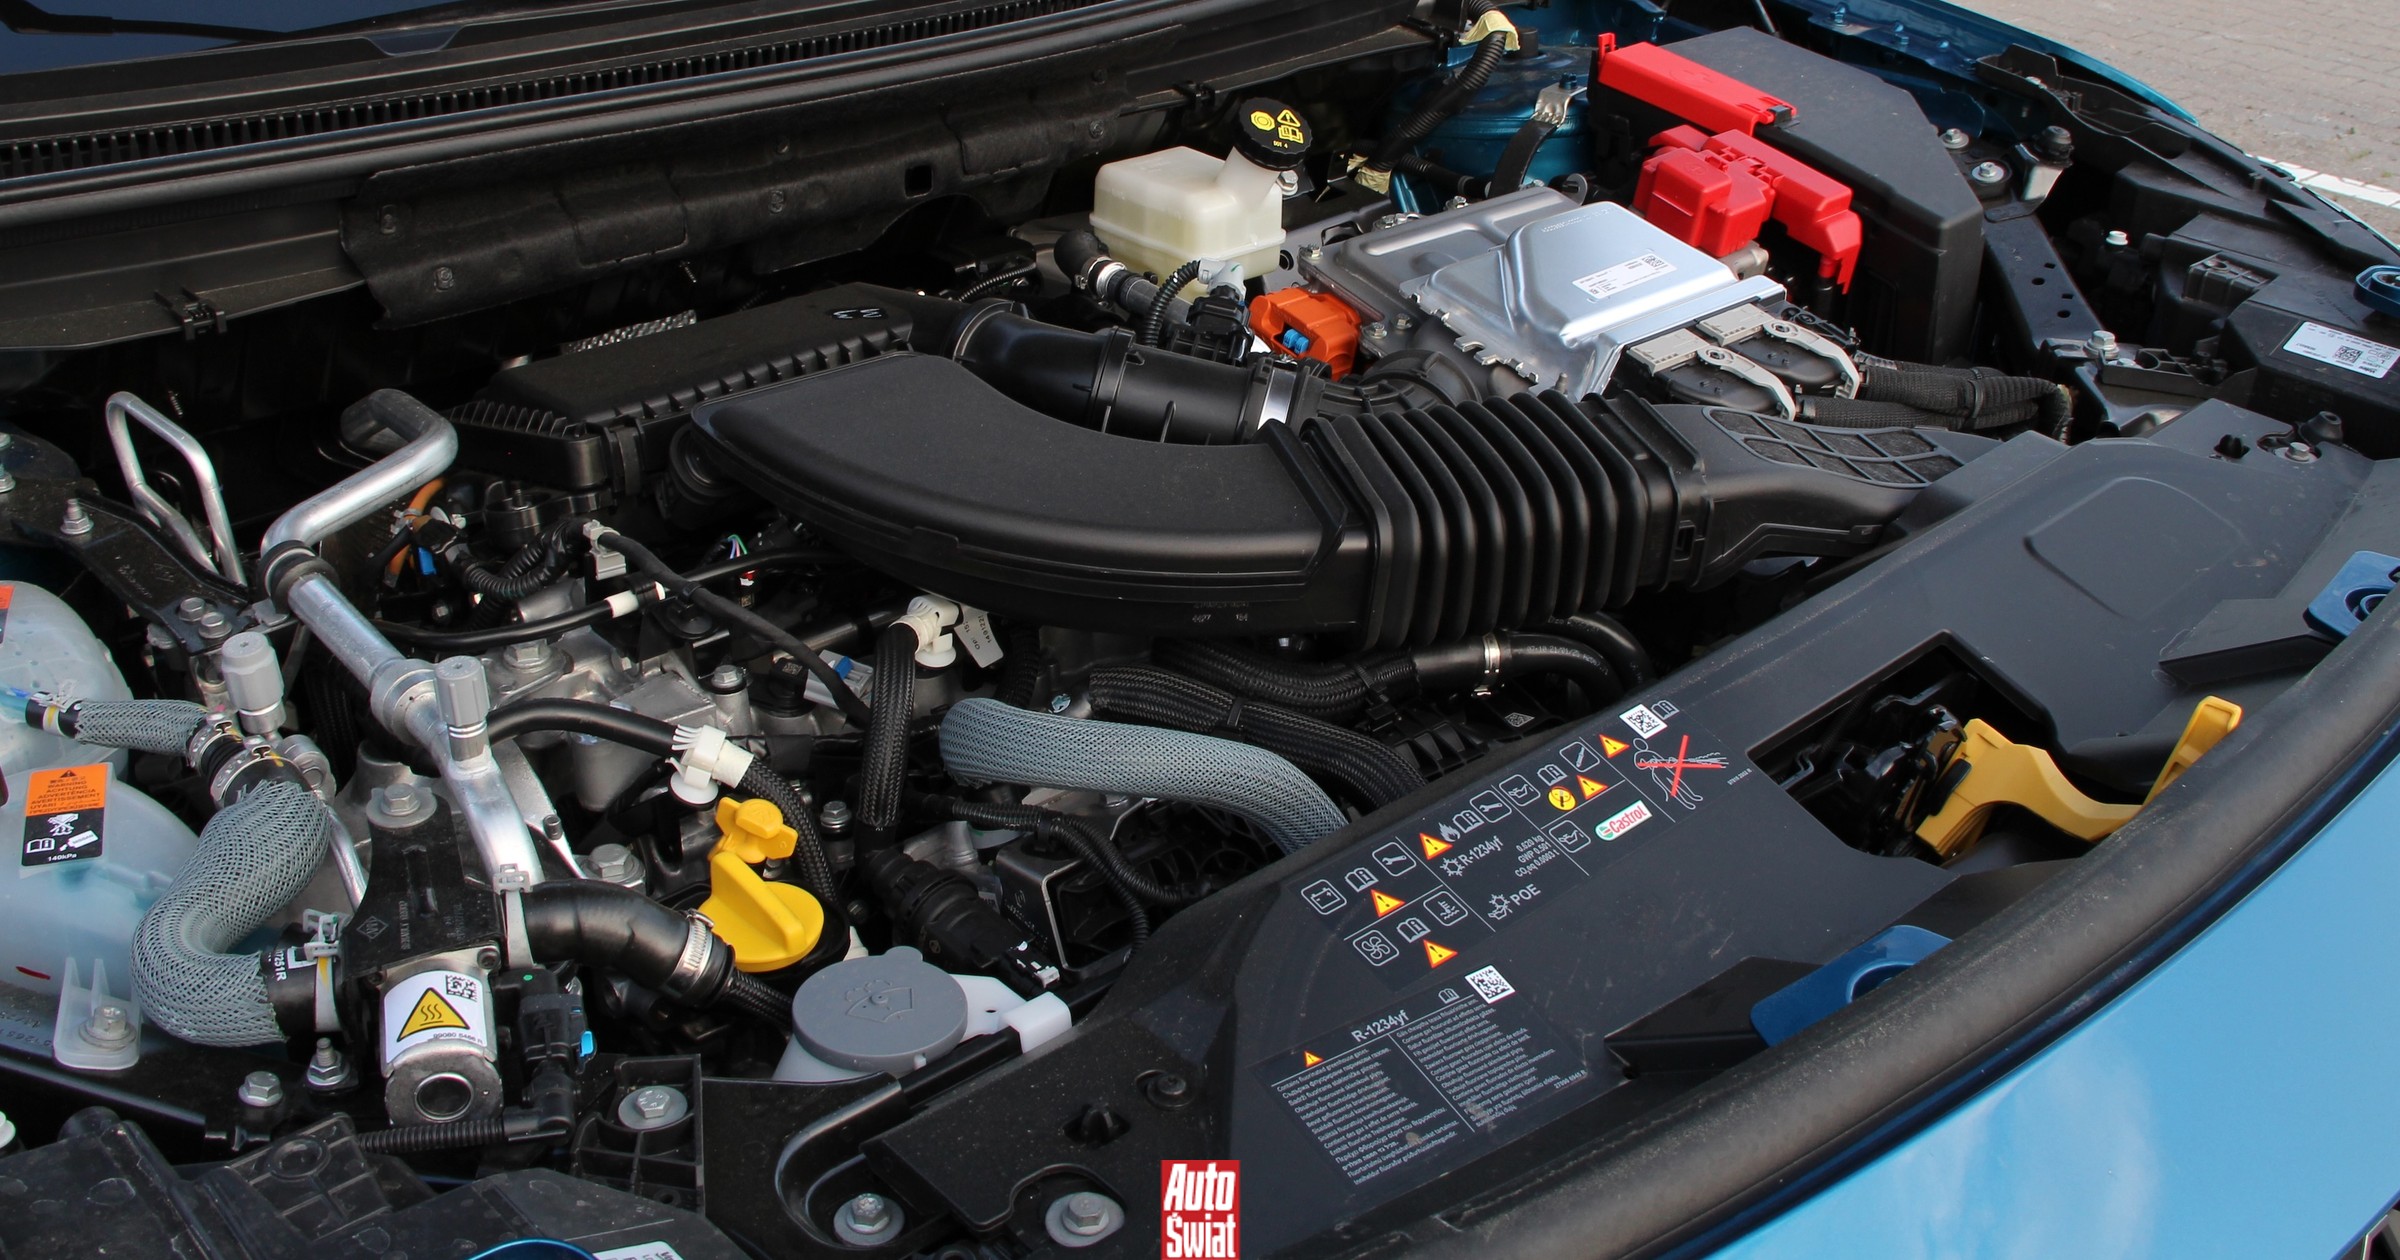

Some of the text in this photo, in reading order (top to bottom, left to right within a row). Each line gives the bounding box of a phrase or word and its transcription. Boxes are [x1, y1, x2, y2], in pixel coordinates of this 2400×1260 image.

[1609, 805, 1647, 833] Castrol
[1458, 835, 1503, 866] R-1234yf
[1516, 835, 1544, 852] 0.620 kg
[1518, 841, 1552, 863] GWP 0.501
[48, 853, 77, 862] 140kPa
[1509, 883, 1540, 904] POE
[1352, 1010, 1409, 1042] R-1234yf
[1276, 1048, 1369, 1092] Contains fluorinated greenhouse gases.
[1324, 1135, 1347, 1149] Contient
[1355, 1127, 1365, 1135] gaz
[1368, 1119, 1380, 1128] effet
[1386, 1110, 1400, 1119] serre
[1329, 1144, 1349, 1156] Enthält
